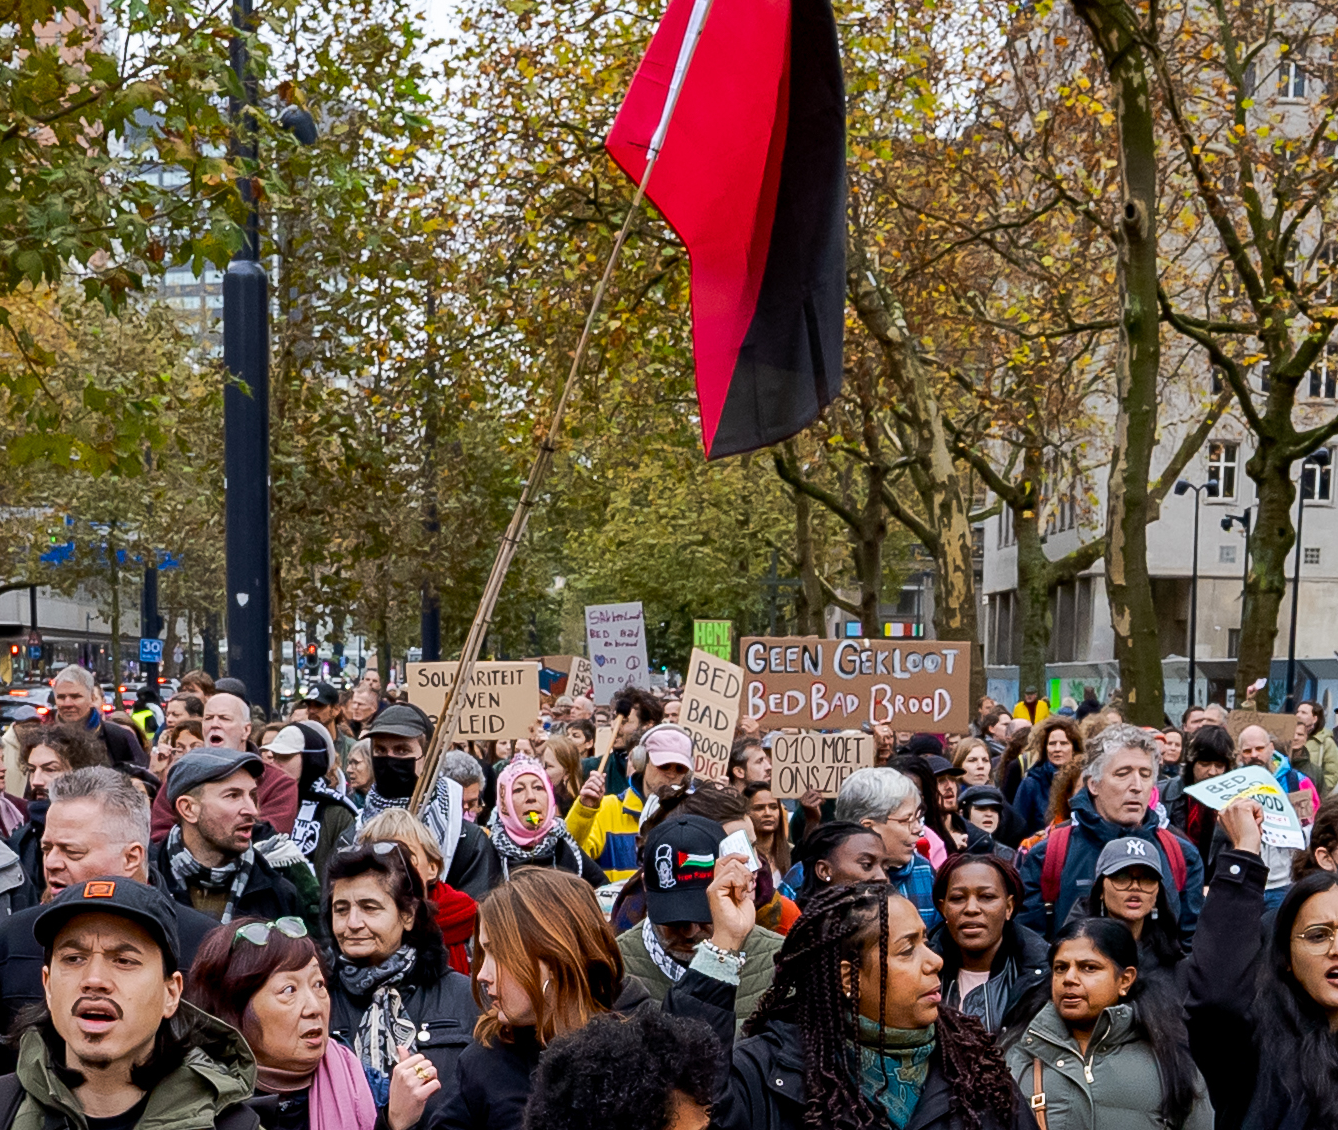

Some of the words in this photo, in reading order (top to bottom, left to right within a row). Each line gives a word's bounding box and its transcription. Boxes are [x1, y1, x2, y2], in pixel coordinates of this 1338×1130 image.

[143, 641, 160, 653] 30
[745, 641, 823, 677] GEEN
[833, 639, 959, 679] GEKLOOT
[695, 660, 740, 699] BED
[687, 698, 729, 731] BAD
[748, 680, 806, 721] BED
[811, 681, 859, 721] BAD
[870, 683, 952, 725] BROOD
[775, 735, 816, 764] 010
[821, 736, 865, 764] MOET
[1205, 775, 1247, 794] BED
